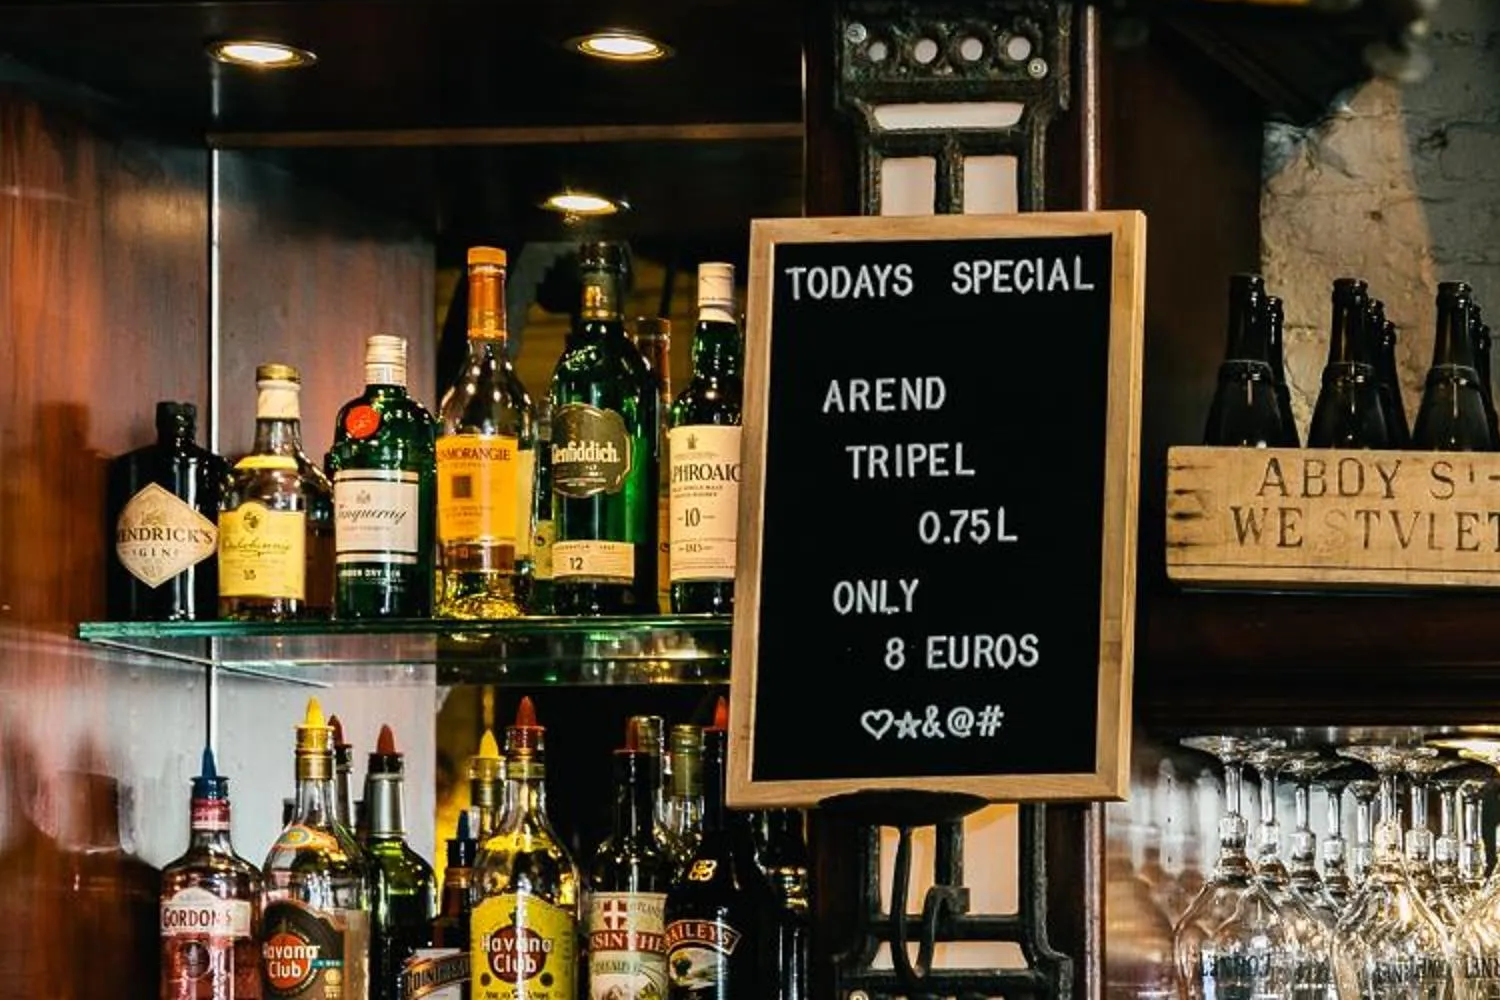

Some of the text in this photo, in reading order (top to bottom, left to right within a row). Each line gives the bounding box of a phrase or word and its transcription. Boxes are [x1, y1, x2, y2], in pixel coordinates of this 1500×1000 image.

[785, 256, 1095, 300] TODAYS SPECIAL
[822, 376, 947, 414] AREND
[845, 442, 975, 479] TRIPEL
[684, 507, 701, 527] 10
[919, 508, 1018, 545] 0.75L
[569, 557, 584, 570] 12
[833, 578, 919, 615] ONLY
[884, 634, 1040, 671] 8 EUROS
[269, 960, 302, 979] Club
